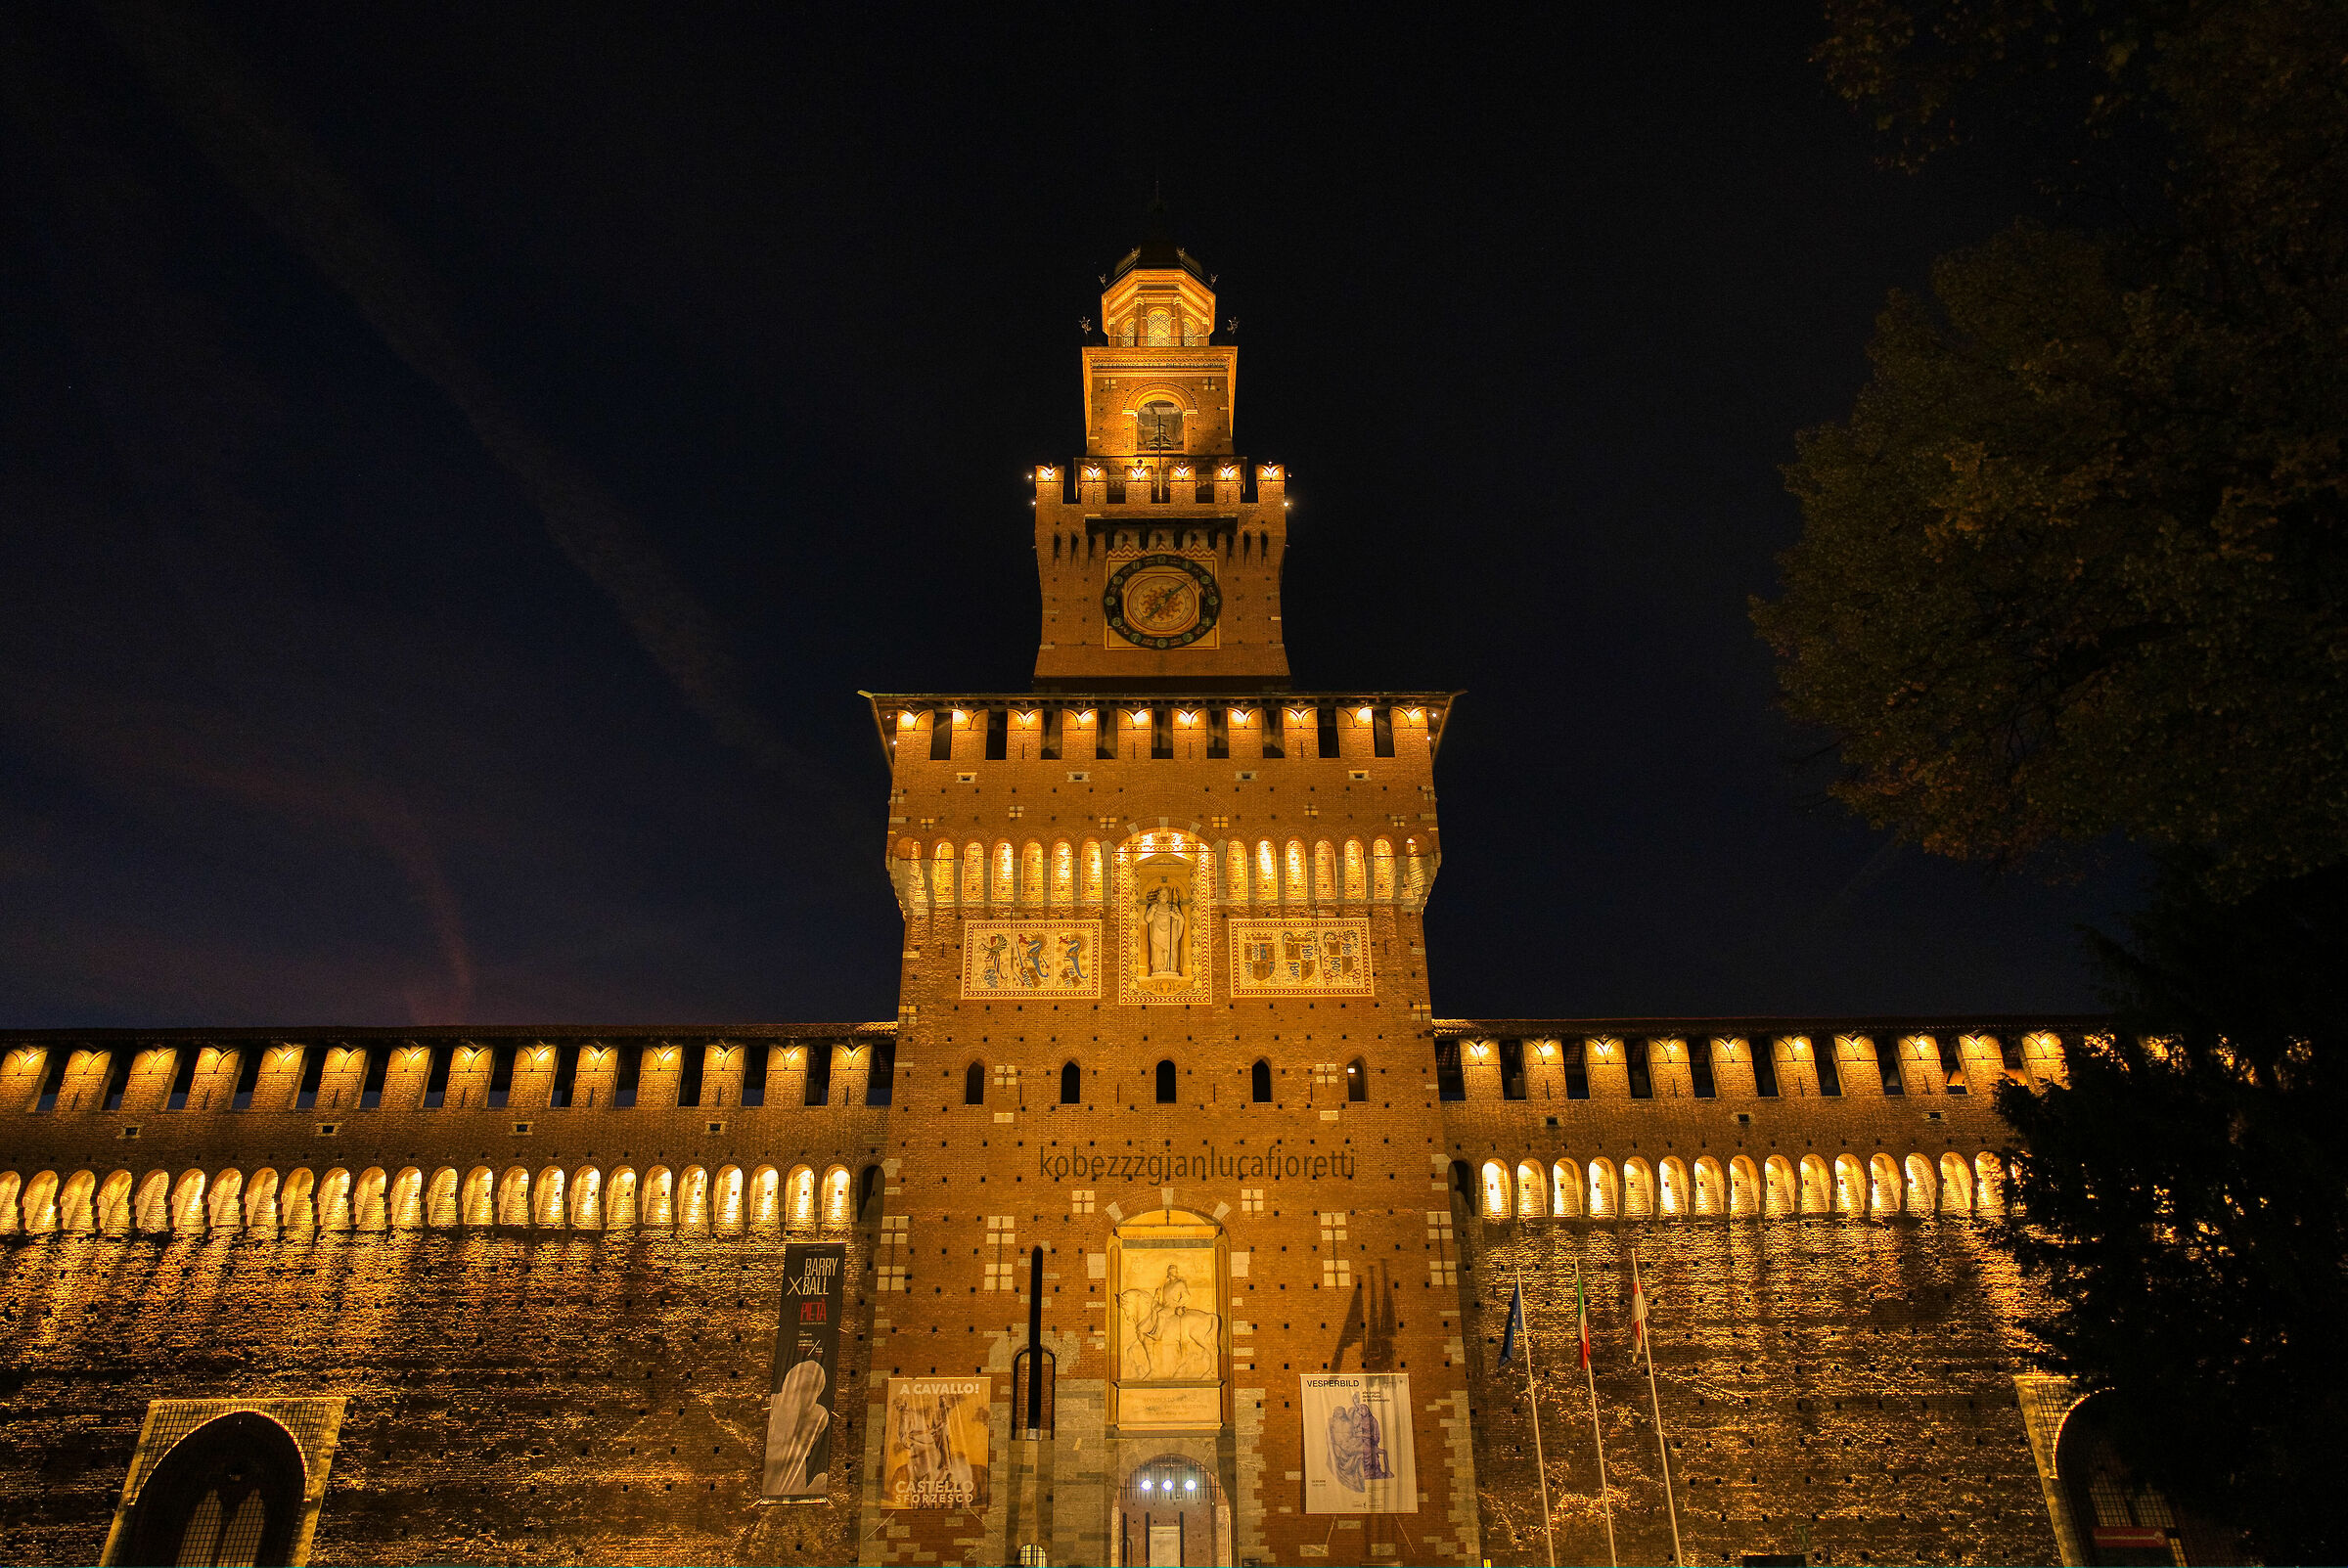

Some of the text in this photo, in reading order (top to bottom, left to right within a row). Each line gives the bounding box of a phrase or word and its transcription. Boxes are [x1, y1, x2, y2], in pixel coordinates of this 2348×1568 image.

[804, 1258, 838, 1277] BARRY
[787, 1277, 830, 1295] X BALL
[799, 1298, 827, 1322] PIETÀ
[899, 1383, 979, 1395] A CAVALLO!
[895, 1481, 974, 1494] CASTELLO
[895, 1494, 973, 1503] SFORZESCO
